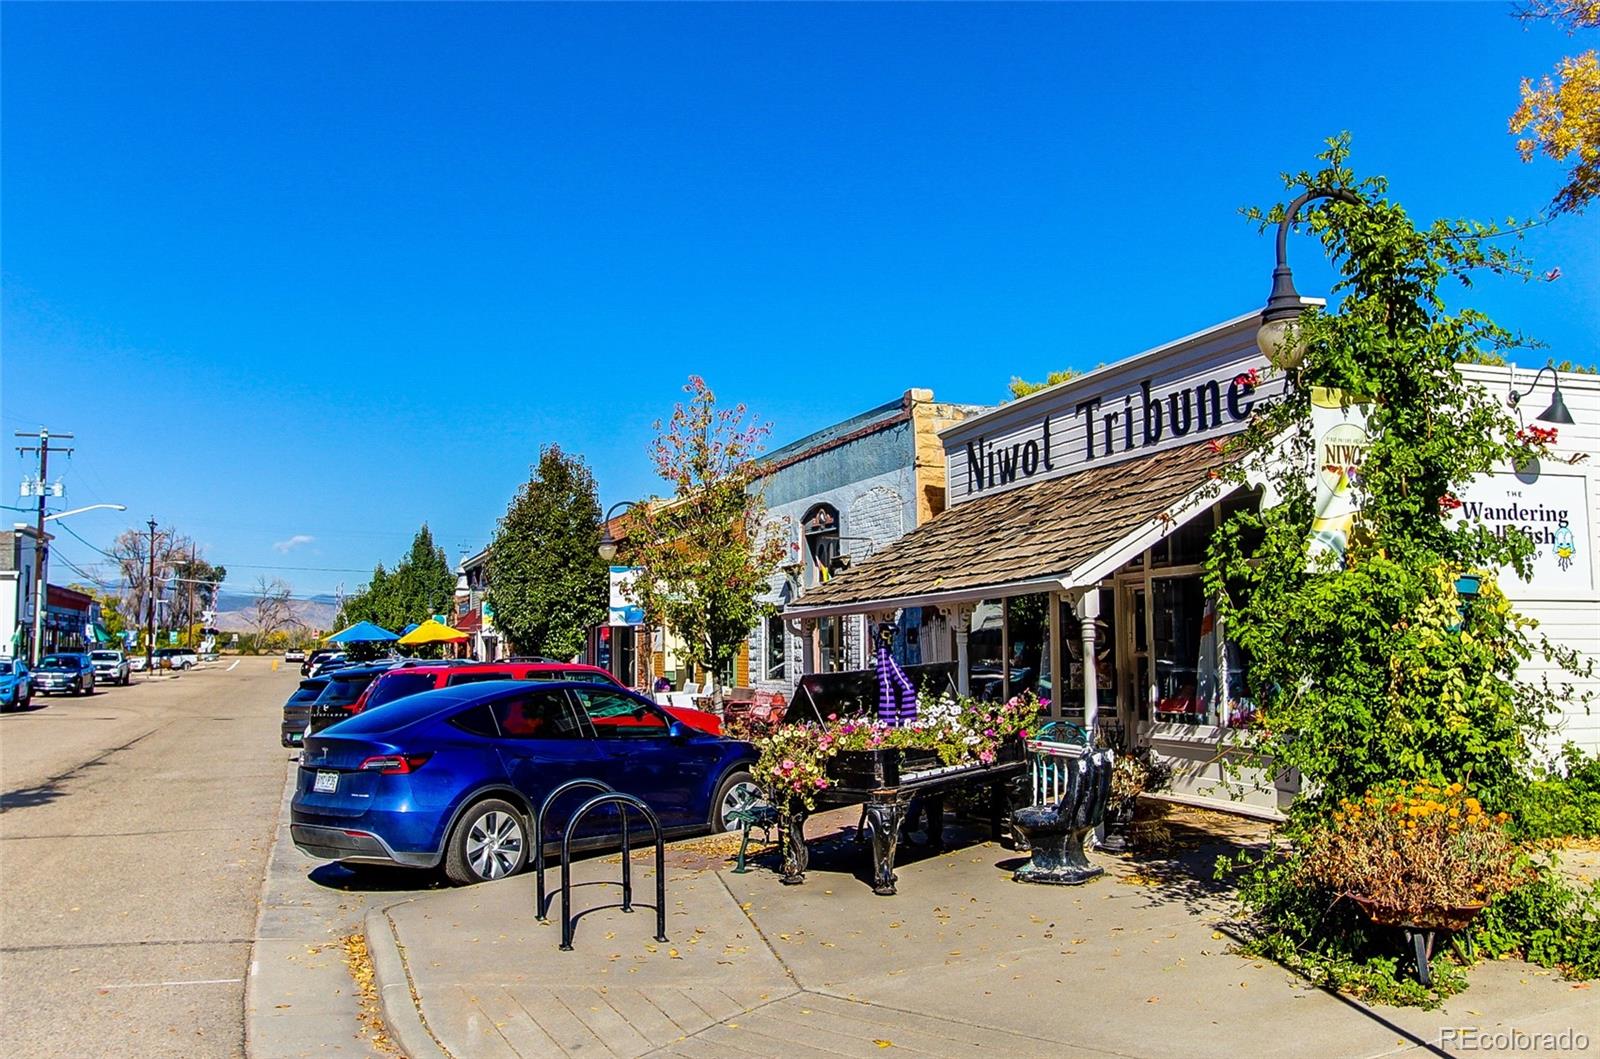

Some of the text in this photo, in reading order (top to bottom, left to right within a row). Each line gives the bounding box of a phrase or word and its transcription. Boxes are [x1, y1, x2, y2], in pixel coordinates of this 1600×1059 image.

[1075, 373, 1257, 462] Tribune
[1325, 443, 1364, 466] NIWO
[1506, 489, 1523, 498] THE
[1461, 501, 1570, 528] Wandering
